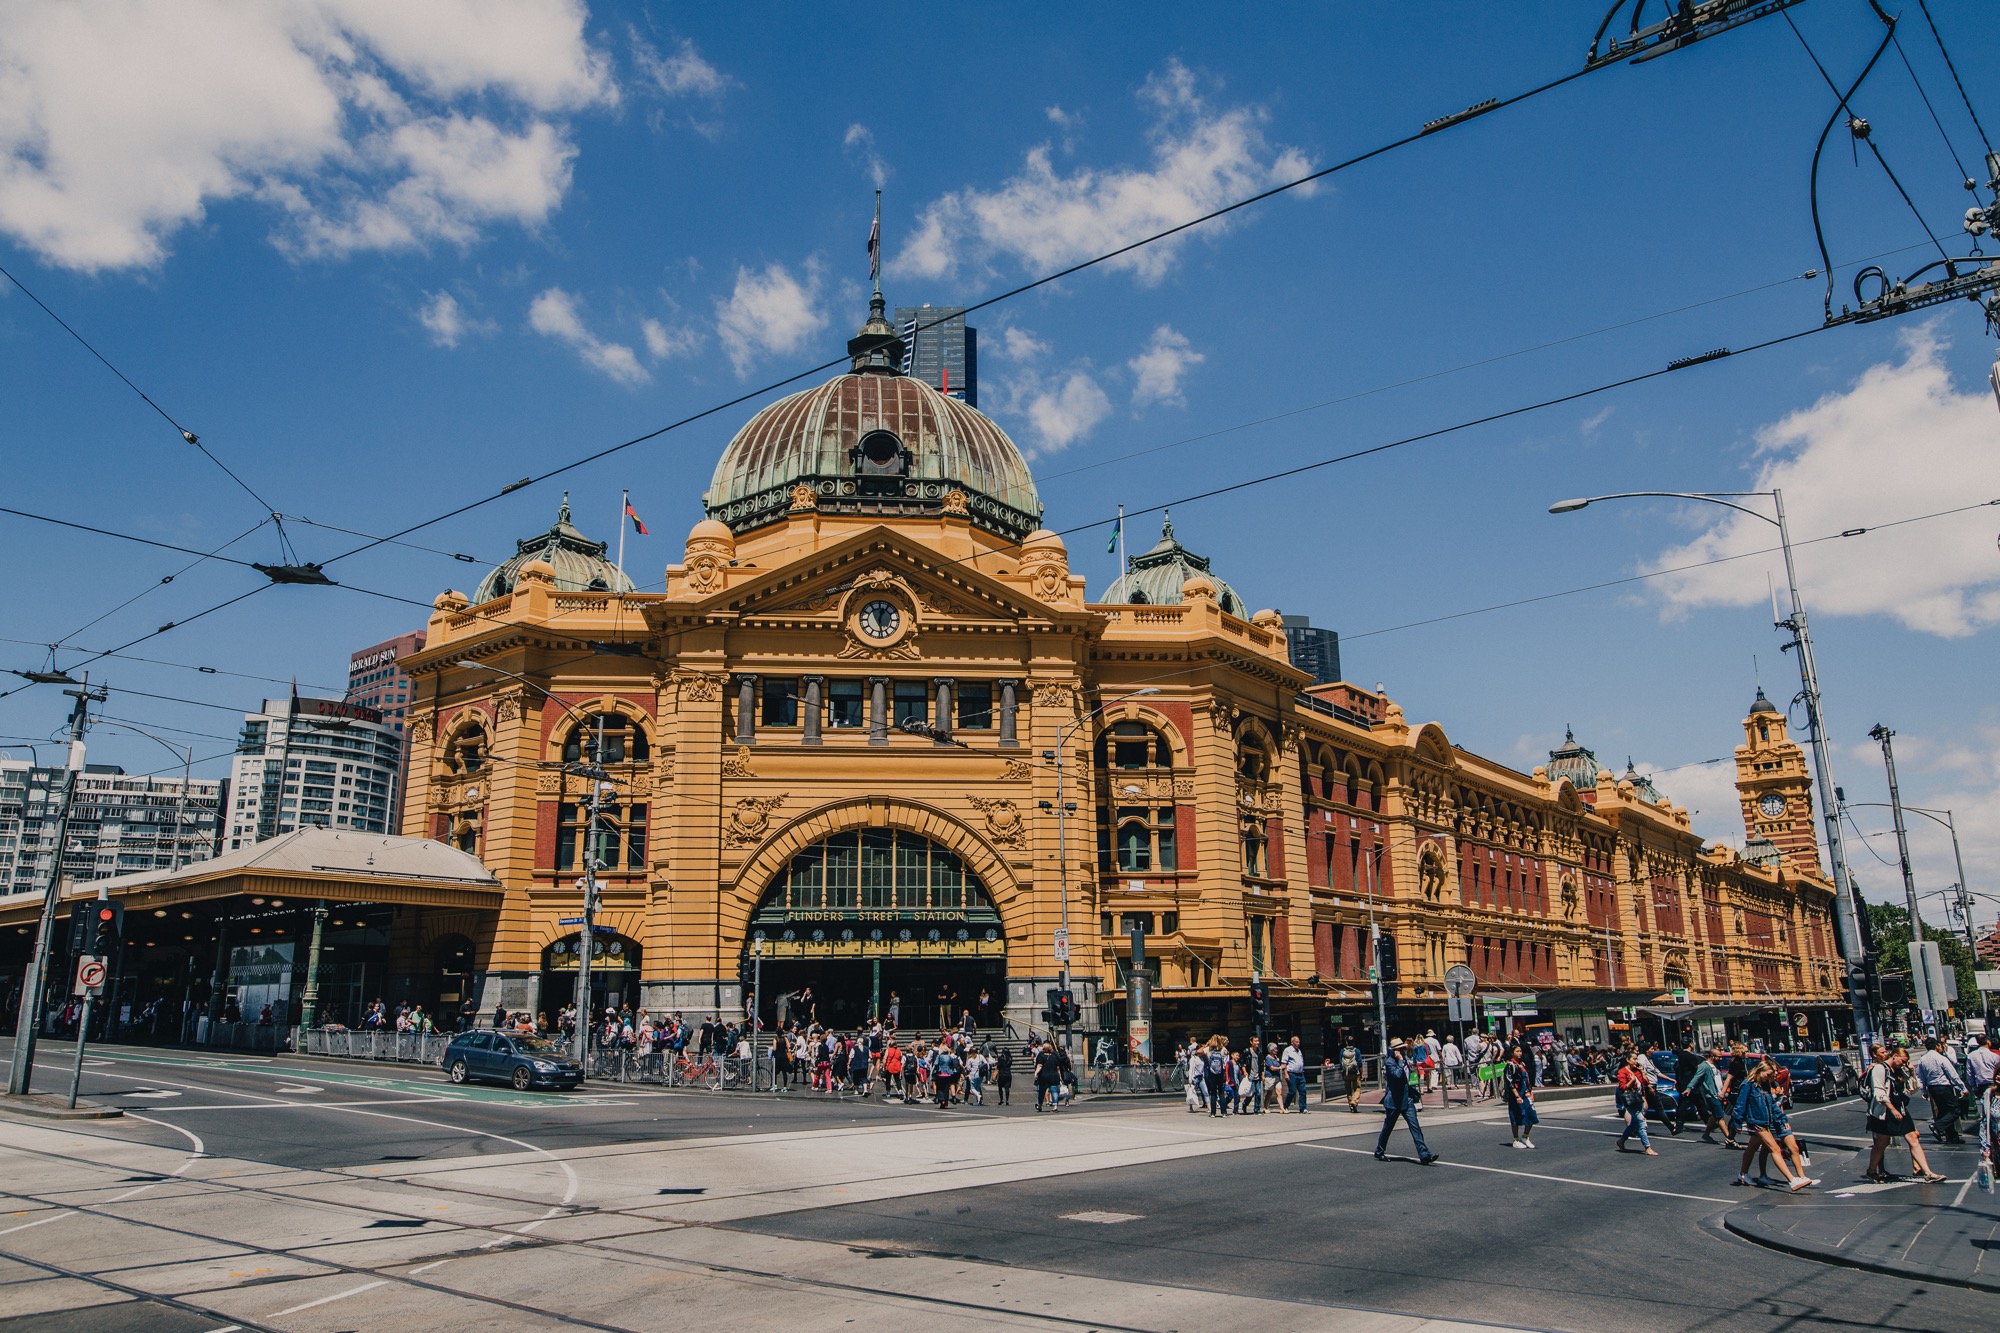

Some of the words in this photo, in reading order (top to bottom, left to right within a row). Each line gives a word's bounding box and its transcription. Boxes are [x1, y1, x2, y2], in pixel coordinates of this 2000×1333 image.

[349, 654, 378, 672] HERALD
[380, 648, 396, 662] SUN
[788, 911, 844, 921] FLINDERS
[858, 911, 900, 921] STREET
[914, 911, 965, 921] STATION
